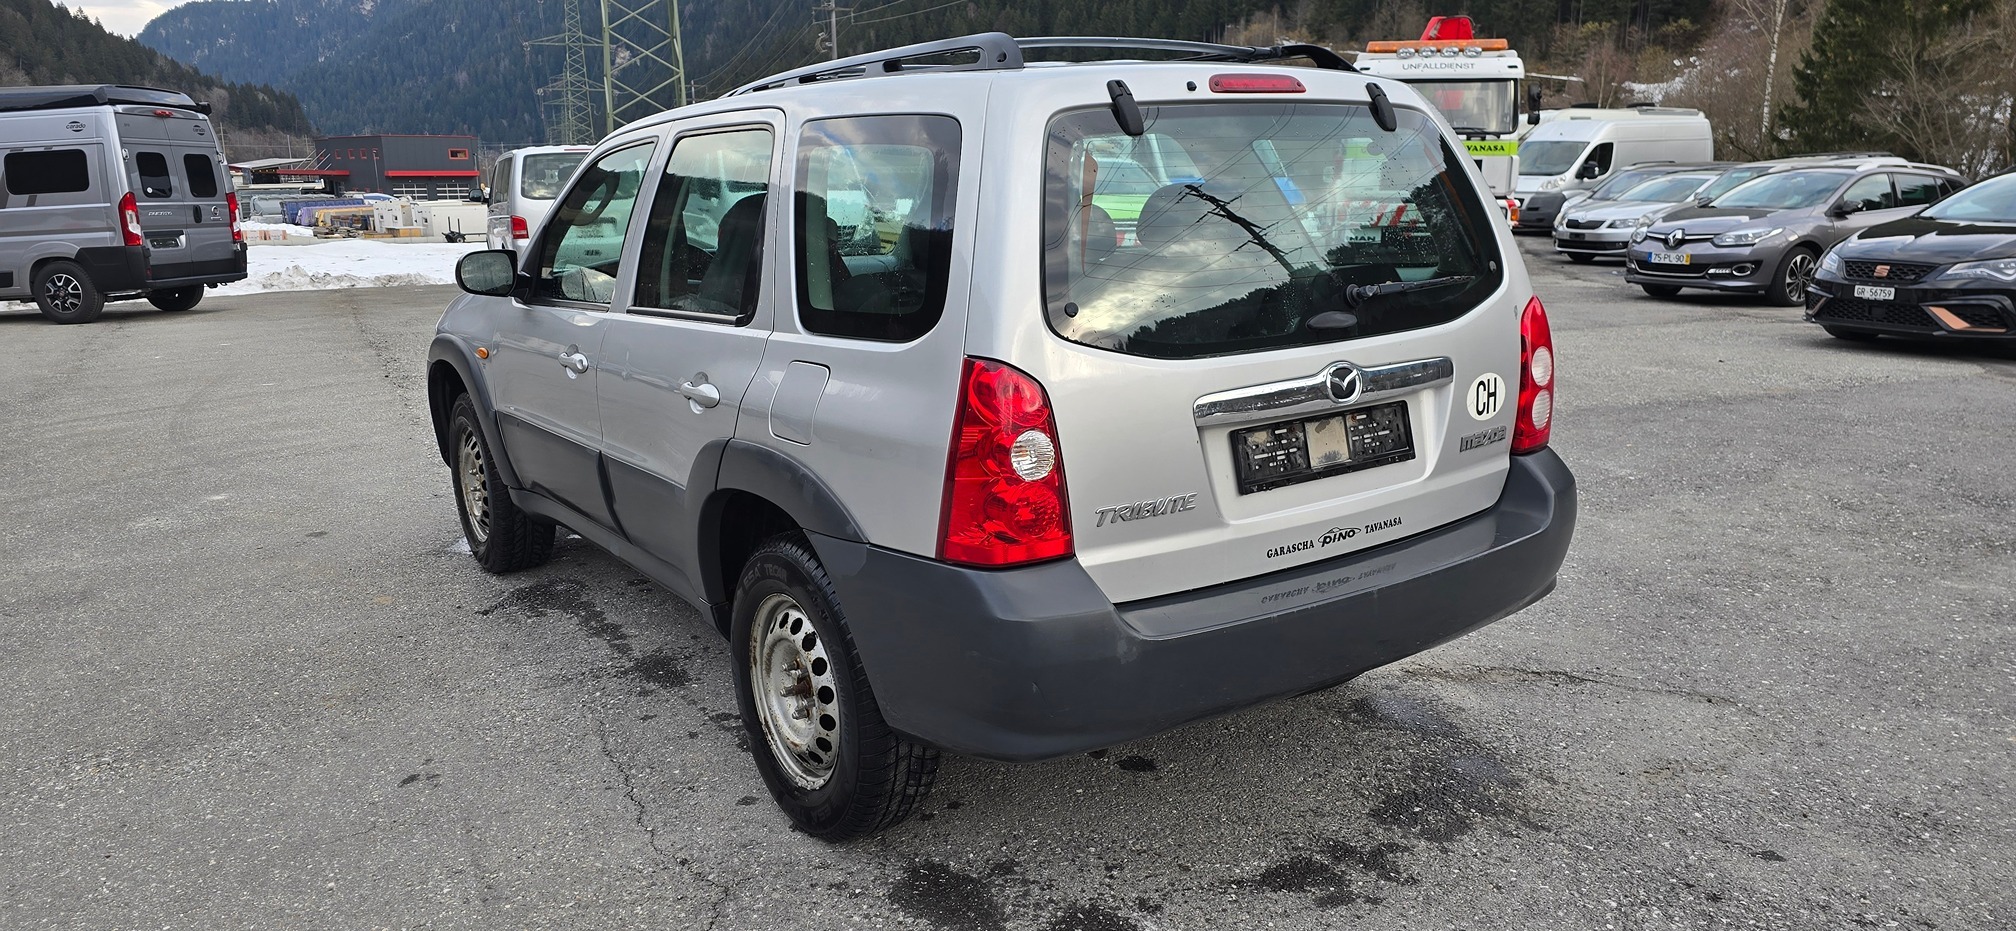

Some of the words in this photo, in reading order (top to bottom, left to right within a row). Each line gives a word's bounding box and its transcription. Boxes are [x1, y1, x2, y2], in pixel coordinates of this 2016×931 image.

[1402, 62, 1475, 70] UNFALLDIENST
[1476, 377, 1497, 416] CH
[1095, 492, 1198, 528] TRIBUTE
[1266, 539, 1315, 559] GARASCHA
[1364, 516, 1403, 534] TAVANASA
